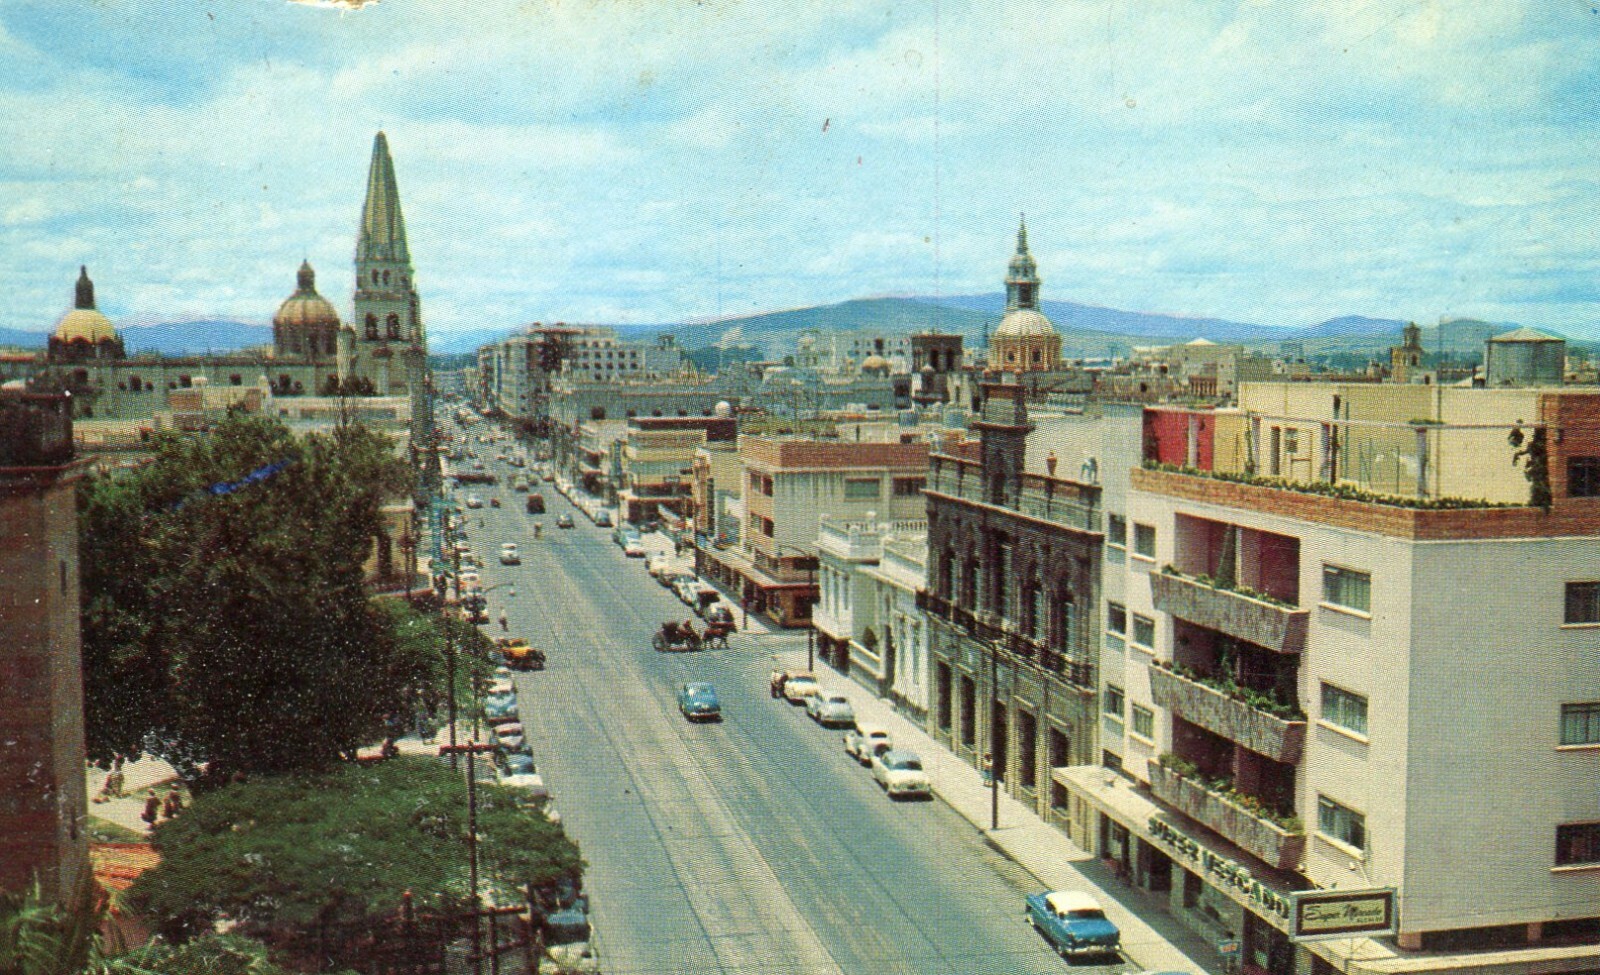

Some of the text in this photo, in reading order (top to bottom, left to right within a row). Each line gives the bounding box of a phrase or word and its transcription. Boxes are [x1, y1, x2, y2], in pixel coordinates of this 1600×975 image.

[1148, 816, 1290, 919] SUPER MERCADO
[1304, 905, 1340, 922] Super
